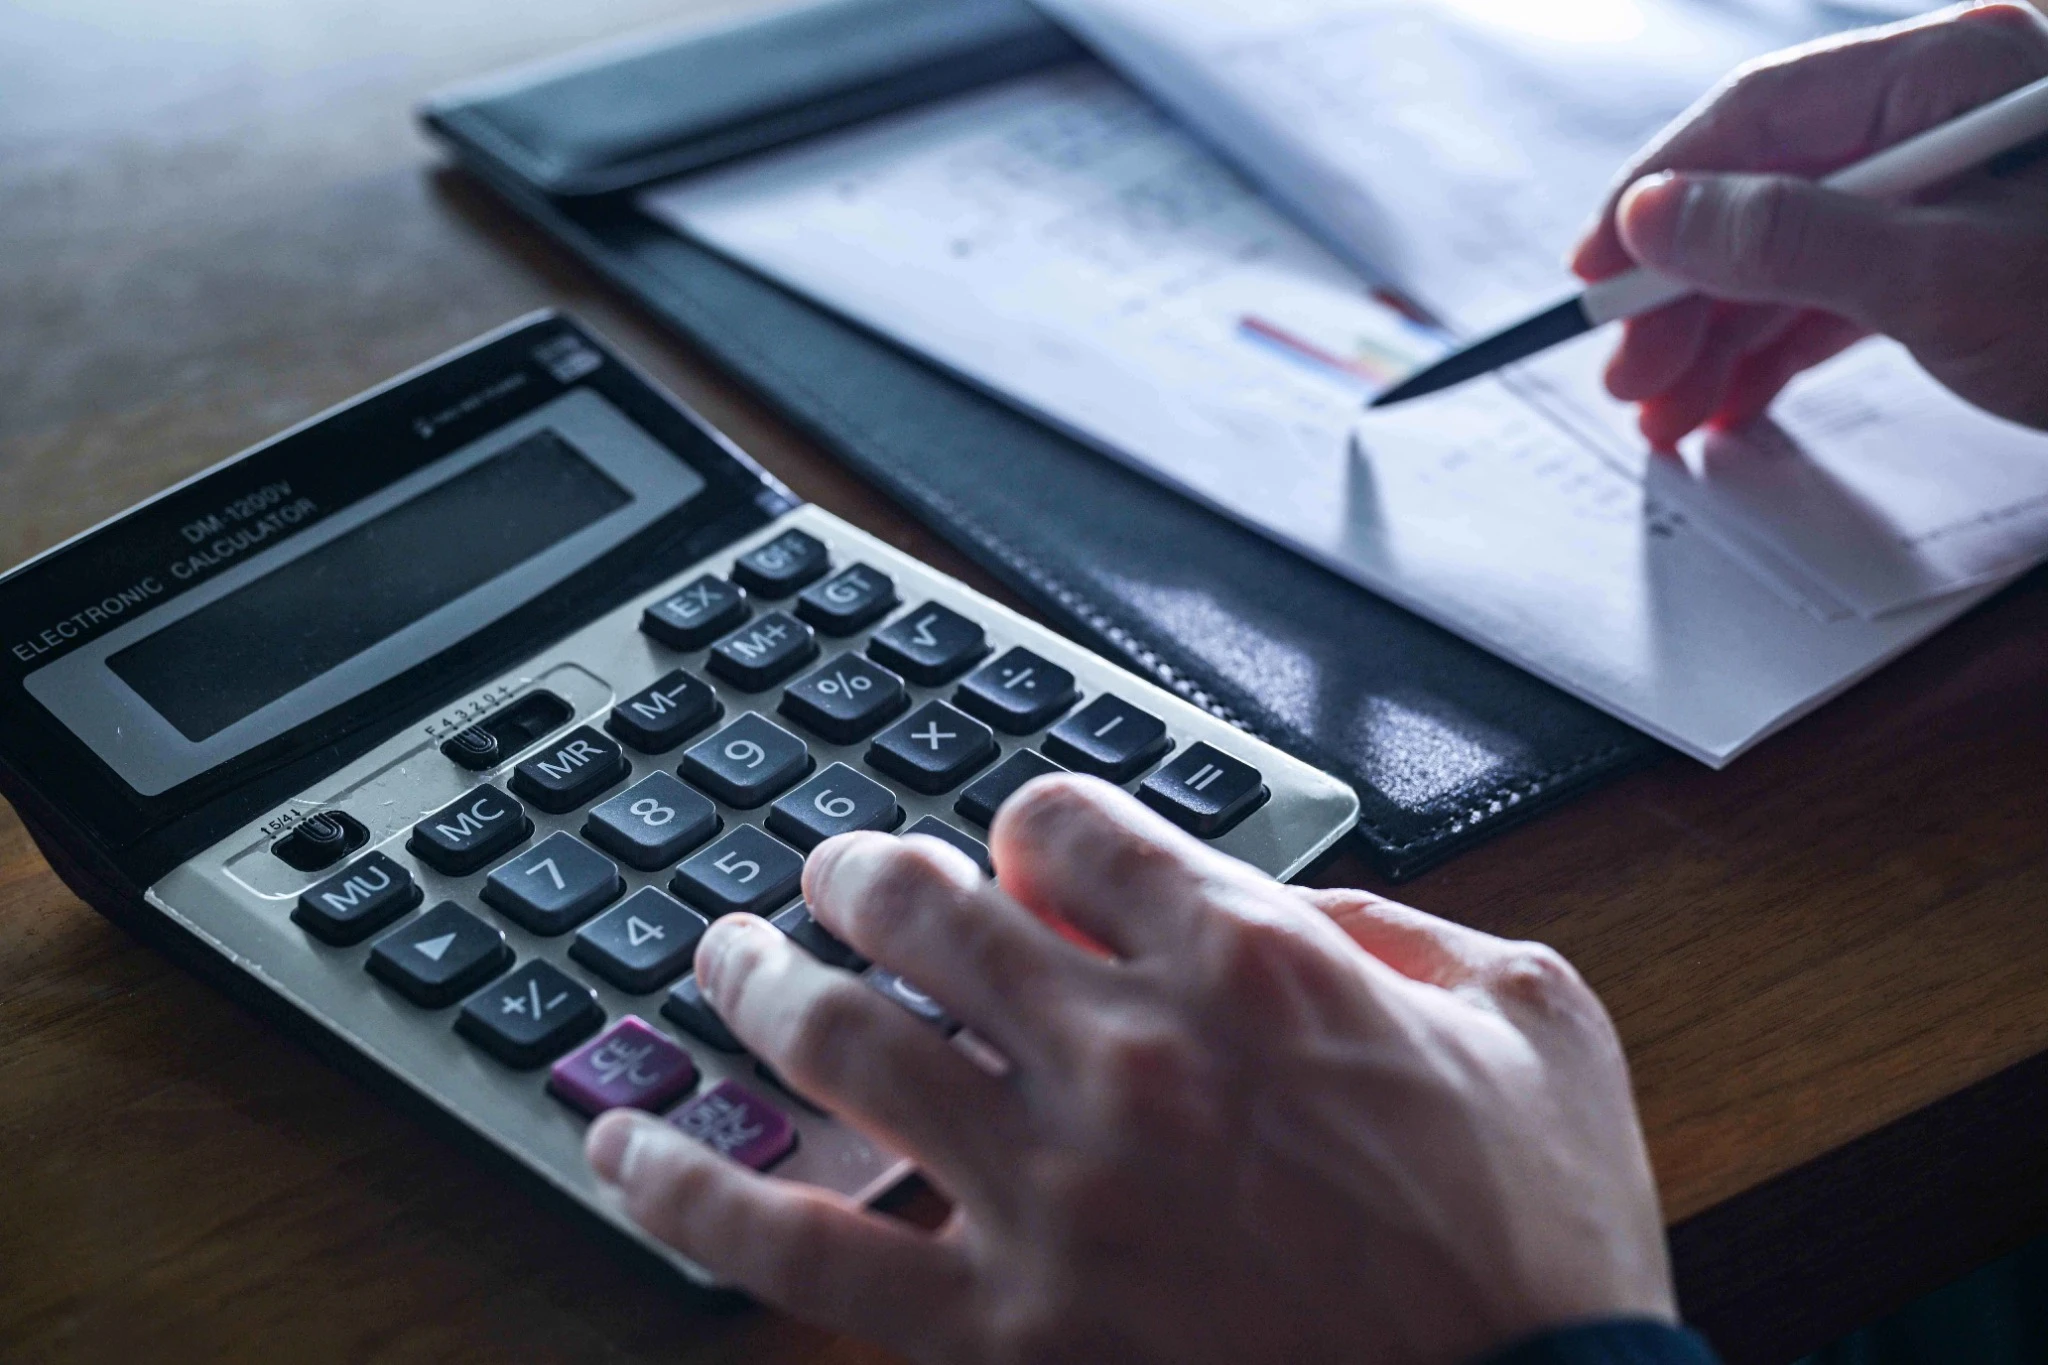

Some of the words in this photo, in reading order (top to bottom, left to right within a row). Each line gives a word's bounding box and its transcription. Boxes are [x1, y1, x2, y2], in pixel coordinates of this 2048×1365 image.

[11, 576, 164, 662] ELECTRONIC
[170, 497, 318, 580] CALCULATOR
[824, 572, 872, 605] GT
[665, 583, 724, 619] EX
[732, 623, 788, 659] M+
[536, 738, 605, 780] MR
[724, 739, 766, 769] 9
[435, 797, 506, 843] MC
[629, 797, 676, 827] 8
[813, 788, 856, 818] 6
[525, 857, 567, 891] 7
[713, 850, 761, 884] 5
[320, 864, 391, 913] MU
[625, 914, 666, 947] 4
